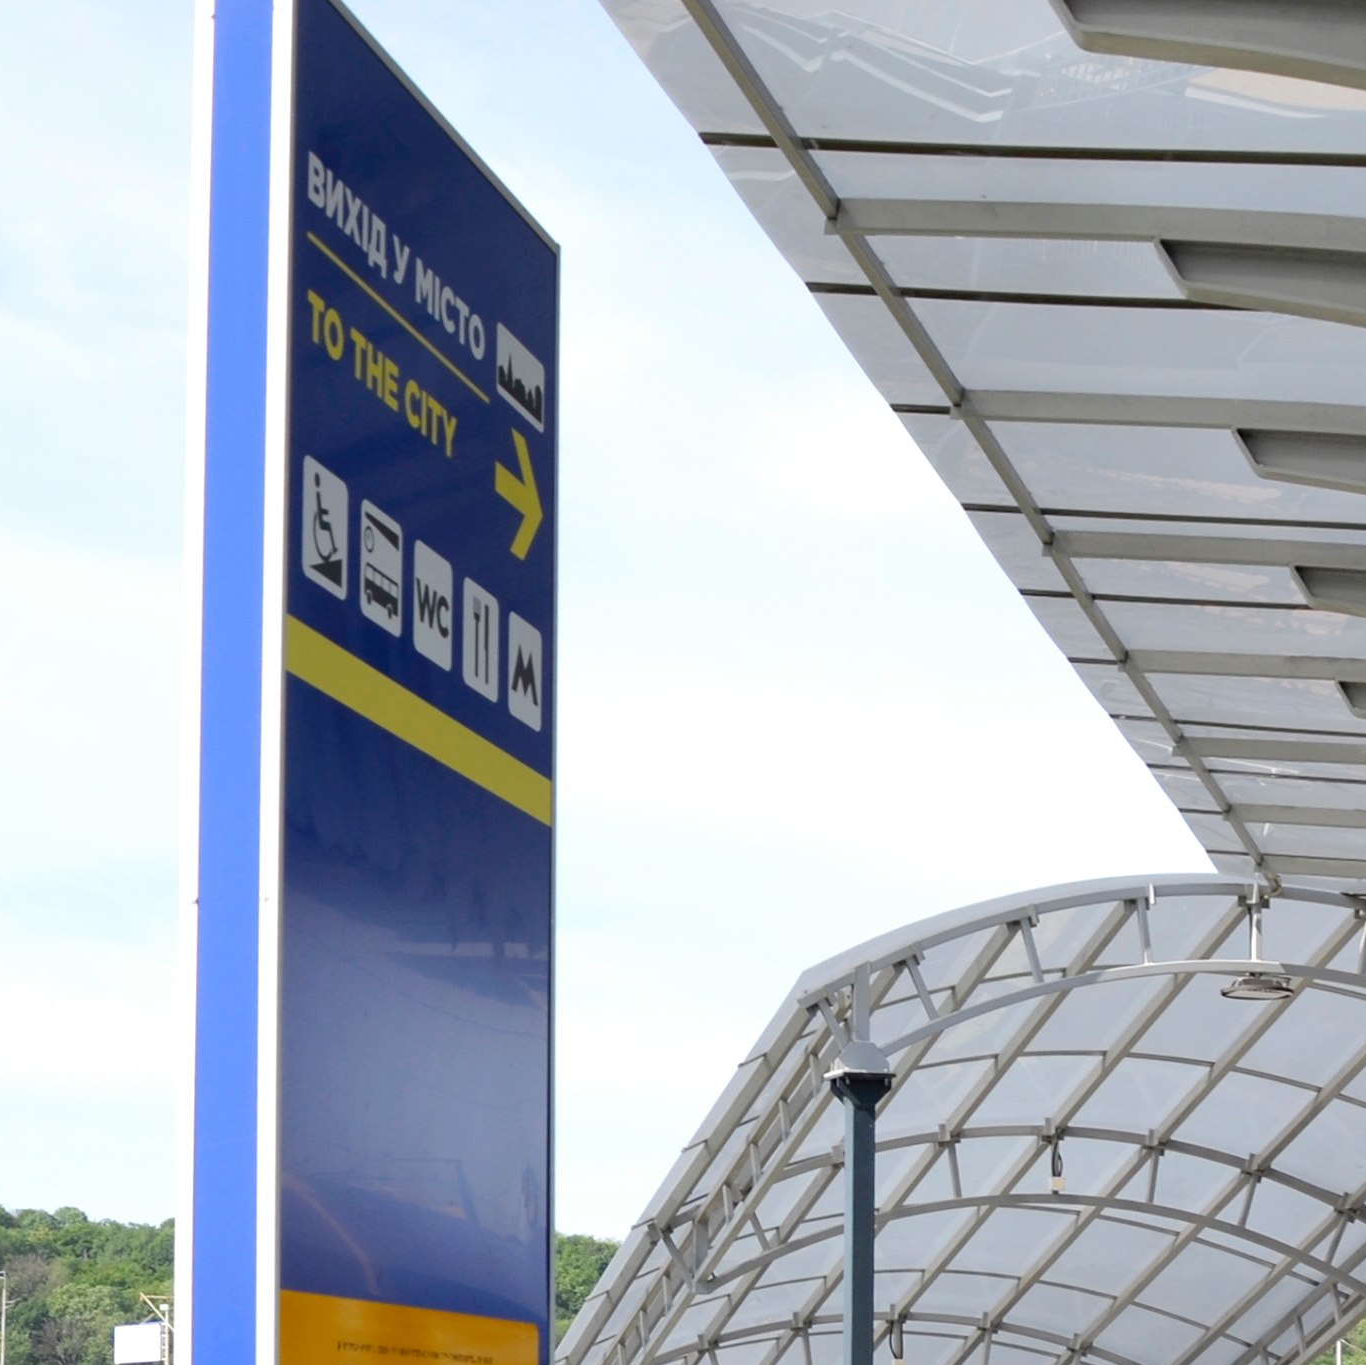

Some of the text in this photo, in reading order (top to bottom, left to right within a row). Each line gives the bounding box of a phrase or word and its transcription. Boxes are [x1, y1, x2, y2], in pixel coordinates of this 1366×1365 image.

[308, 151, 485, 360] ВИХІД У МІСТО
[308, 289, 457, 457] TO THE CITY
[416, 578, 449, 638] WC
